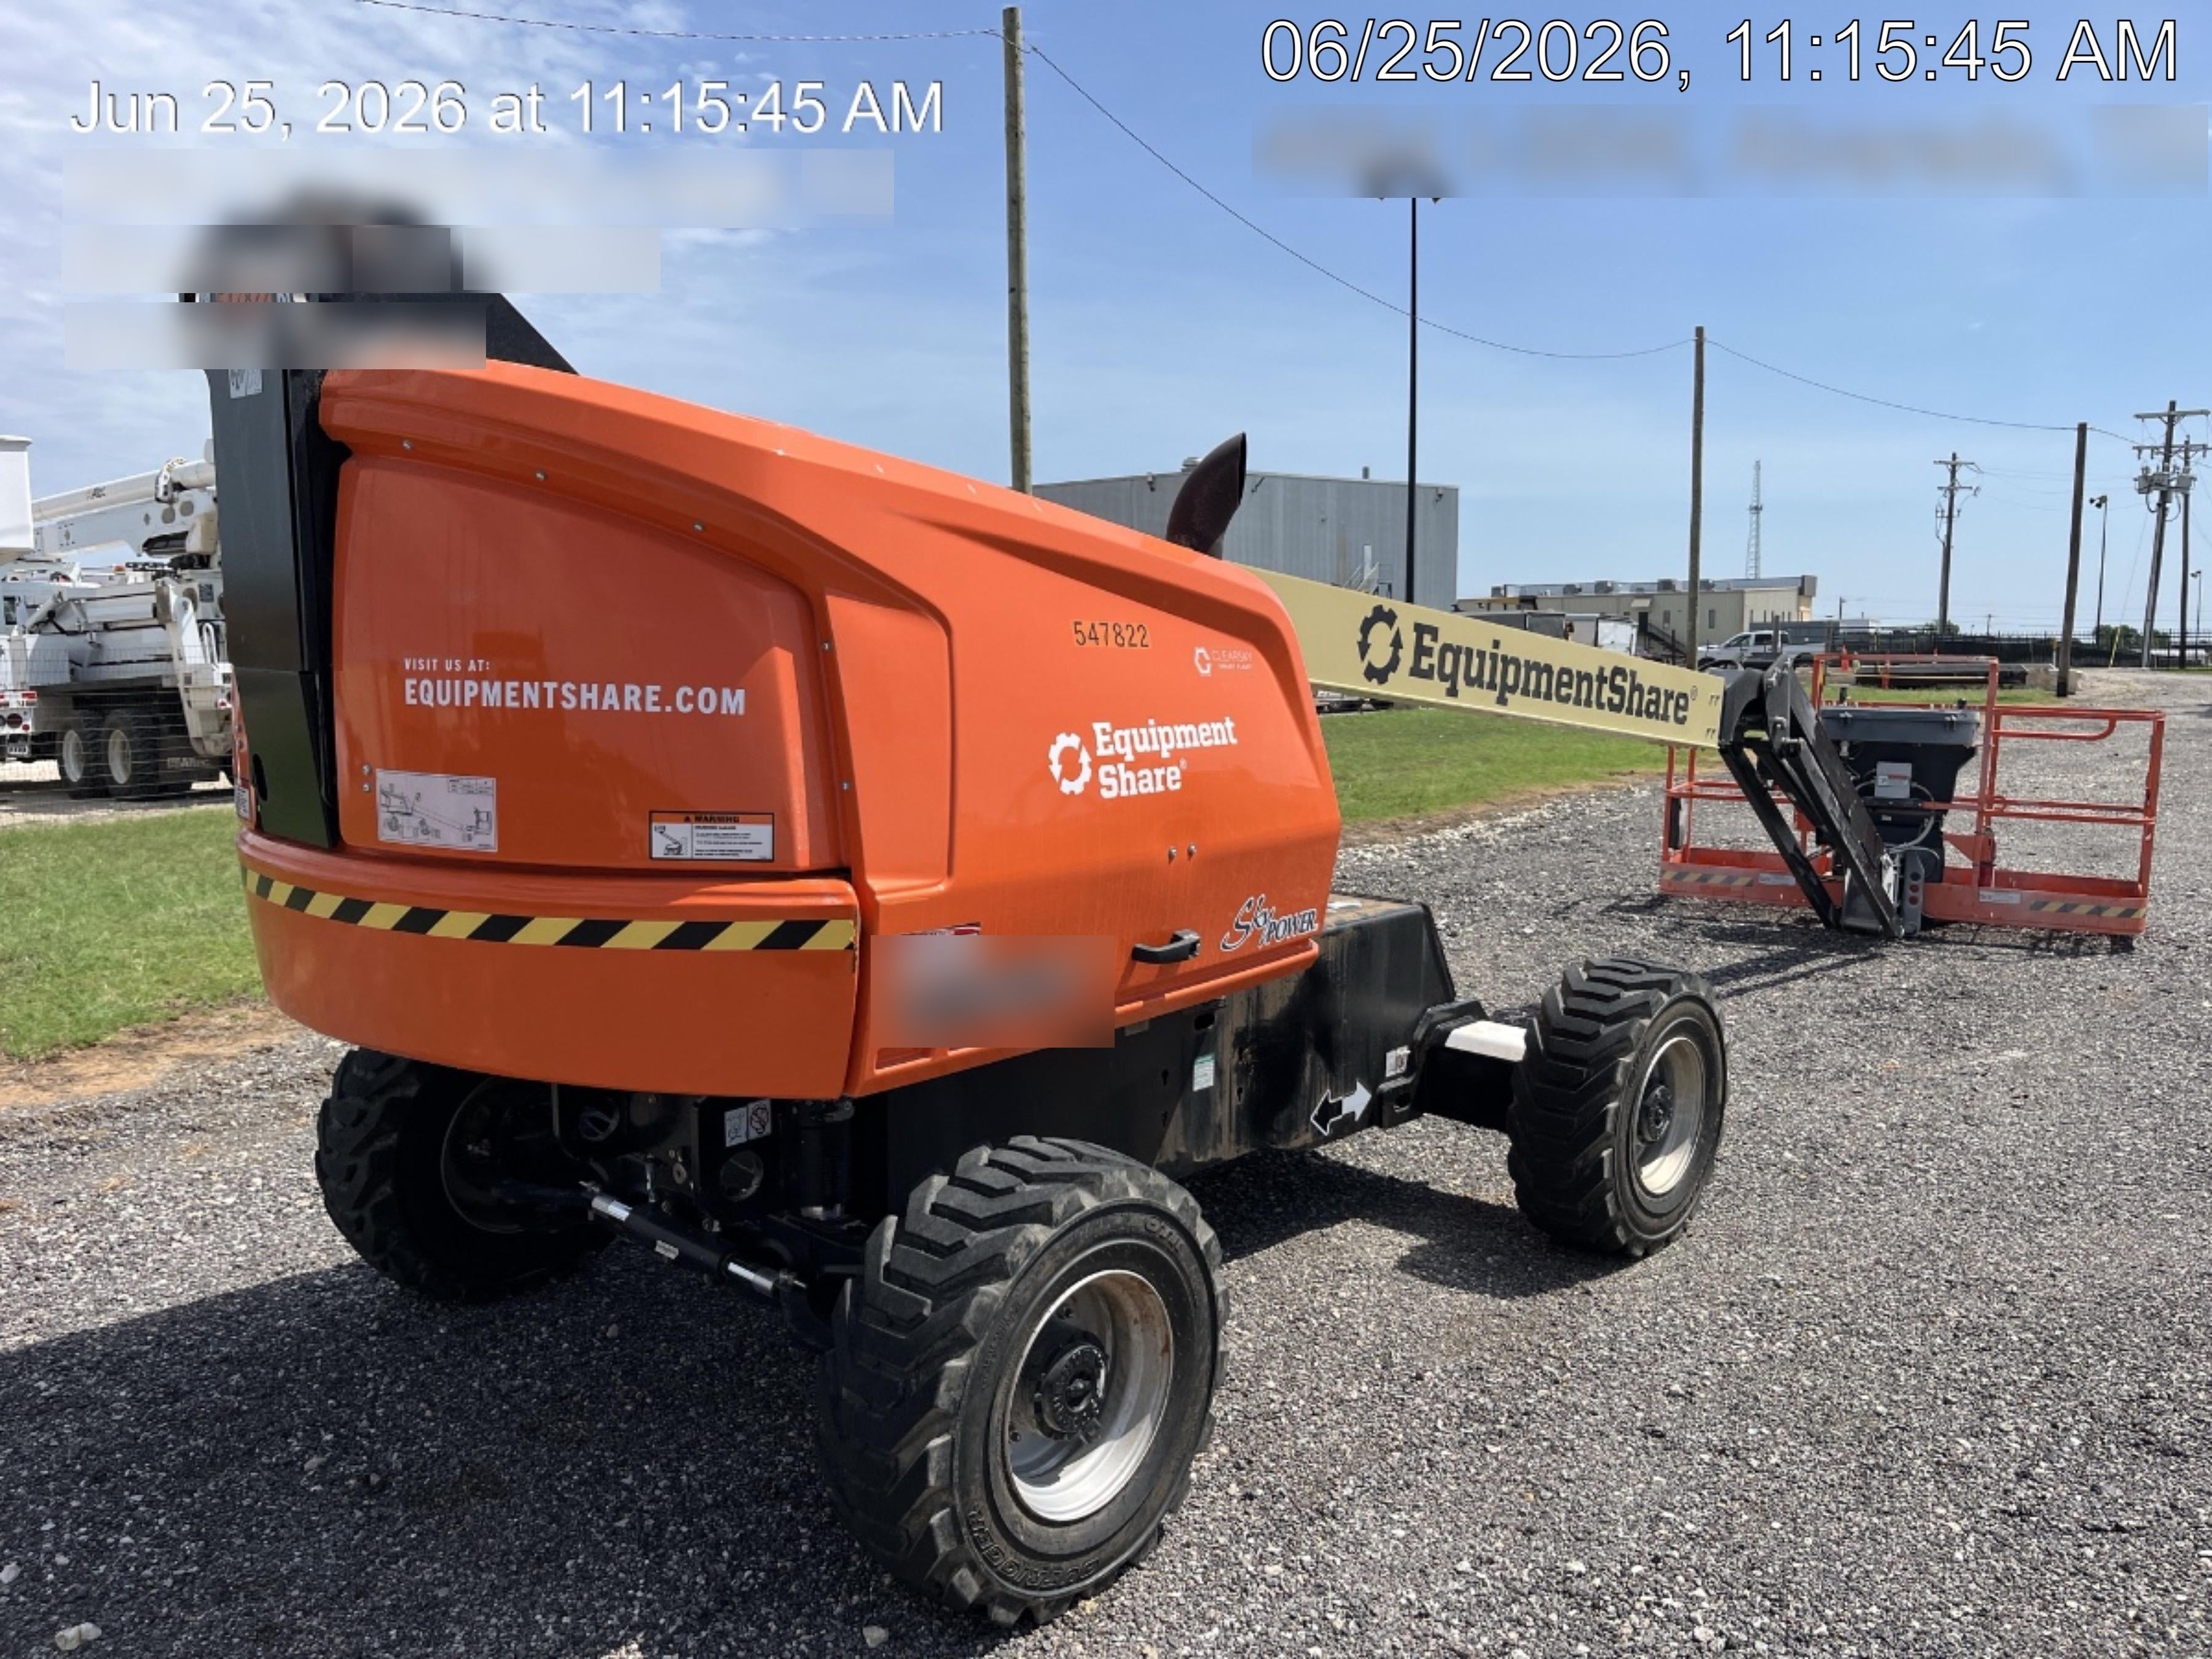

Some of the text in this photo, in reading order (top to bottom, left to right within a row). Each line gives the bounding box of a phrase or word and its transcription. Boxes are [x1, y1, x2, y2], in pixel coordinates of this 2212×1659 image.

[1073, 621, 1150, 648] 547822
[404, 658, 490, 672] VISIT US AT:
[405, 678, 745, 715] EQUIPMENTSHARE.COM
[1091, 716, 1239, 762] Equipment
